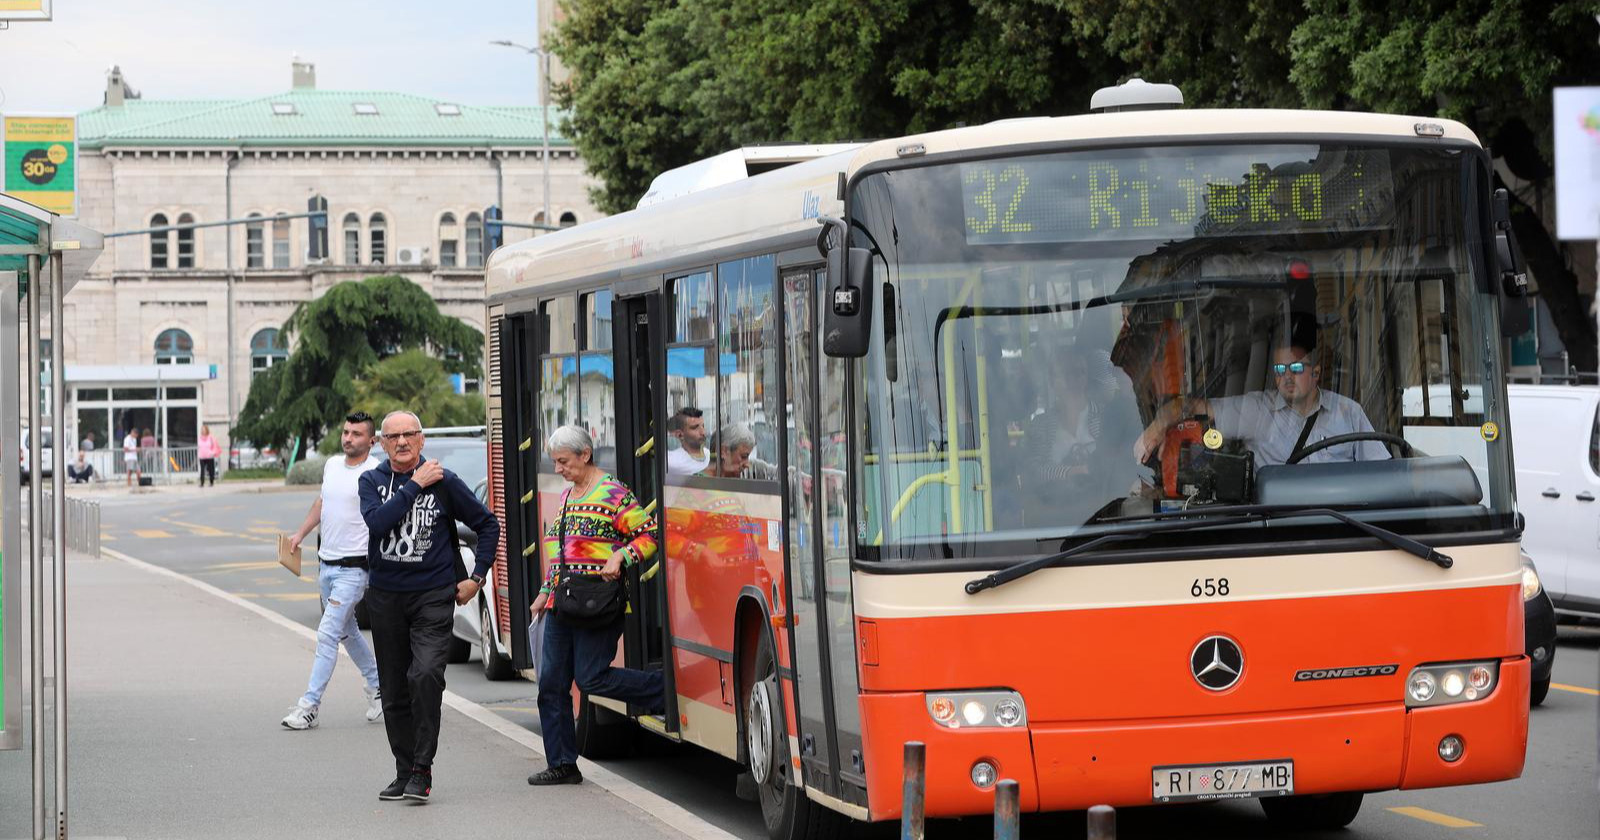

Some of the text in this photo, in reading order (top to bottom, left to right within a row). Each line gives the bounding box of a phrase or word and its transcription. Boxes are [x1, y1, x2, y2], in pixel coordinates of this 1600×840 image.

[24, 162, 44, 176] 30
[802, 190, 820, 220] Ulaz
[966, 156, 1323, 233] 32 Rijeka
[1190, 577, 1230, 597] 658
[1297, 665, 1395, 679] CONECTO
[1169, 765, 1288, 793] RI 877 MB
